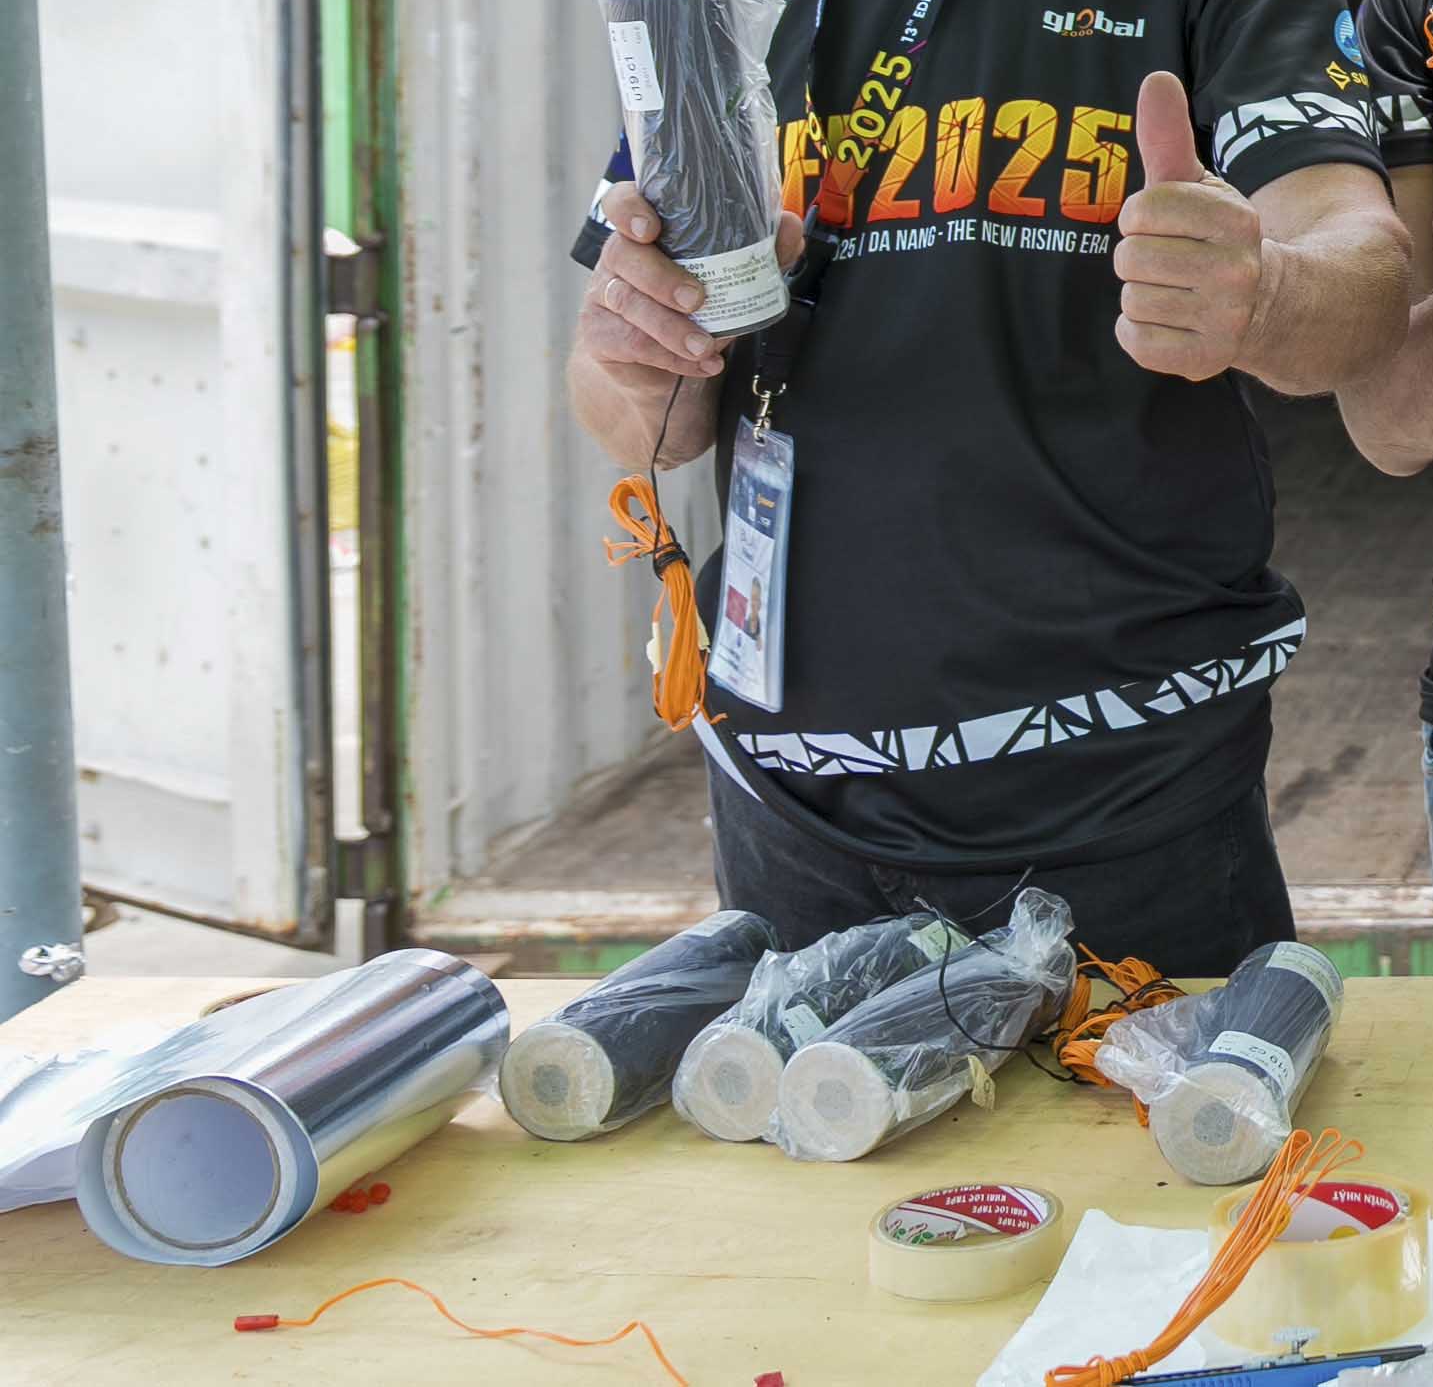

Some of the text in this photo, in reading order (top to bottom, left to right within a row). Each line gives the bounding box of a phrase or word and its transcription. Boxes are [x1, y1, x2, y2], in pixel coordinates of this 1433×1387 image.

[1042, 8, 1146, 37] global
[838, 50, 912, 170] 2025
[868, 231, 892, 254] DA
[895, 225, 936, 252] NANG
[946, 218, 978, 243] THE
[981, 222, 1017, 249] NEW
[1020, 226, 1076, 254] RISING
[1079, 232, 1111, 256] ERA
[945, 1196, 967, 1206] TAPE
[971, 1205, 993, 1215] TAPE
